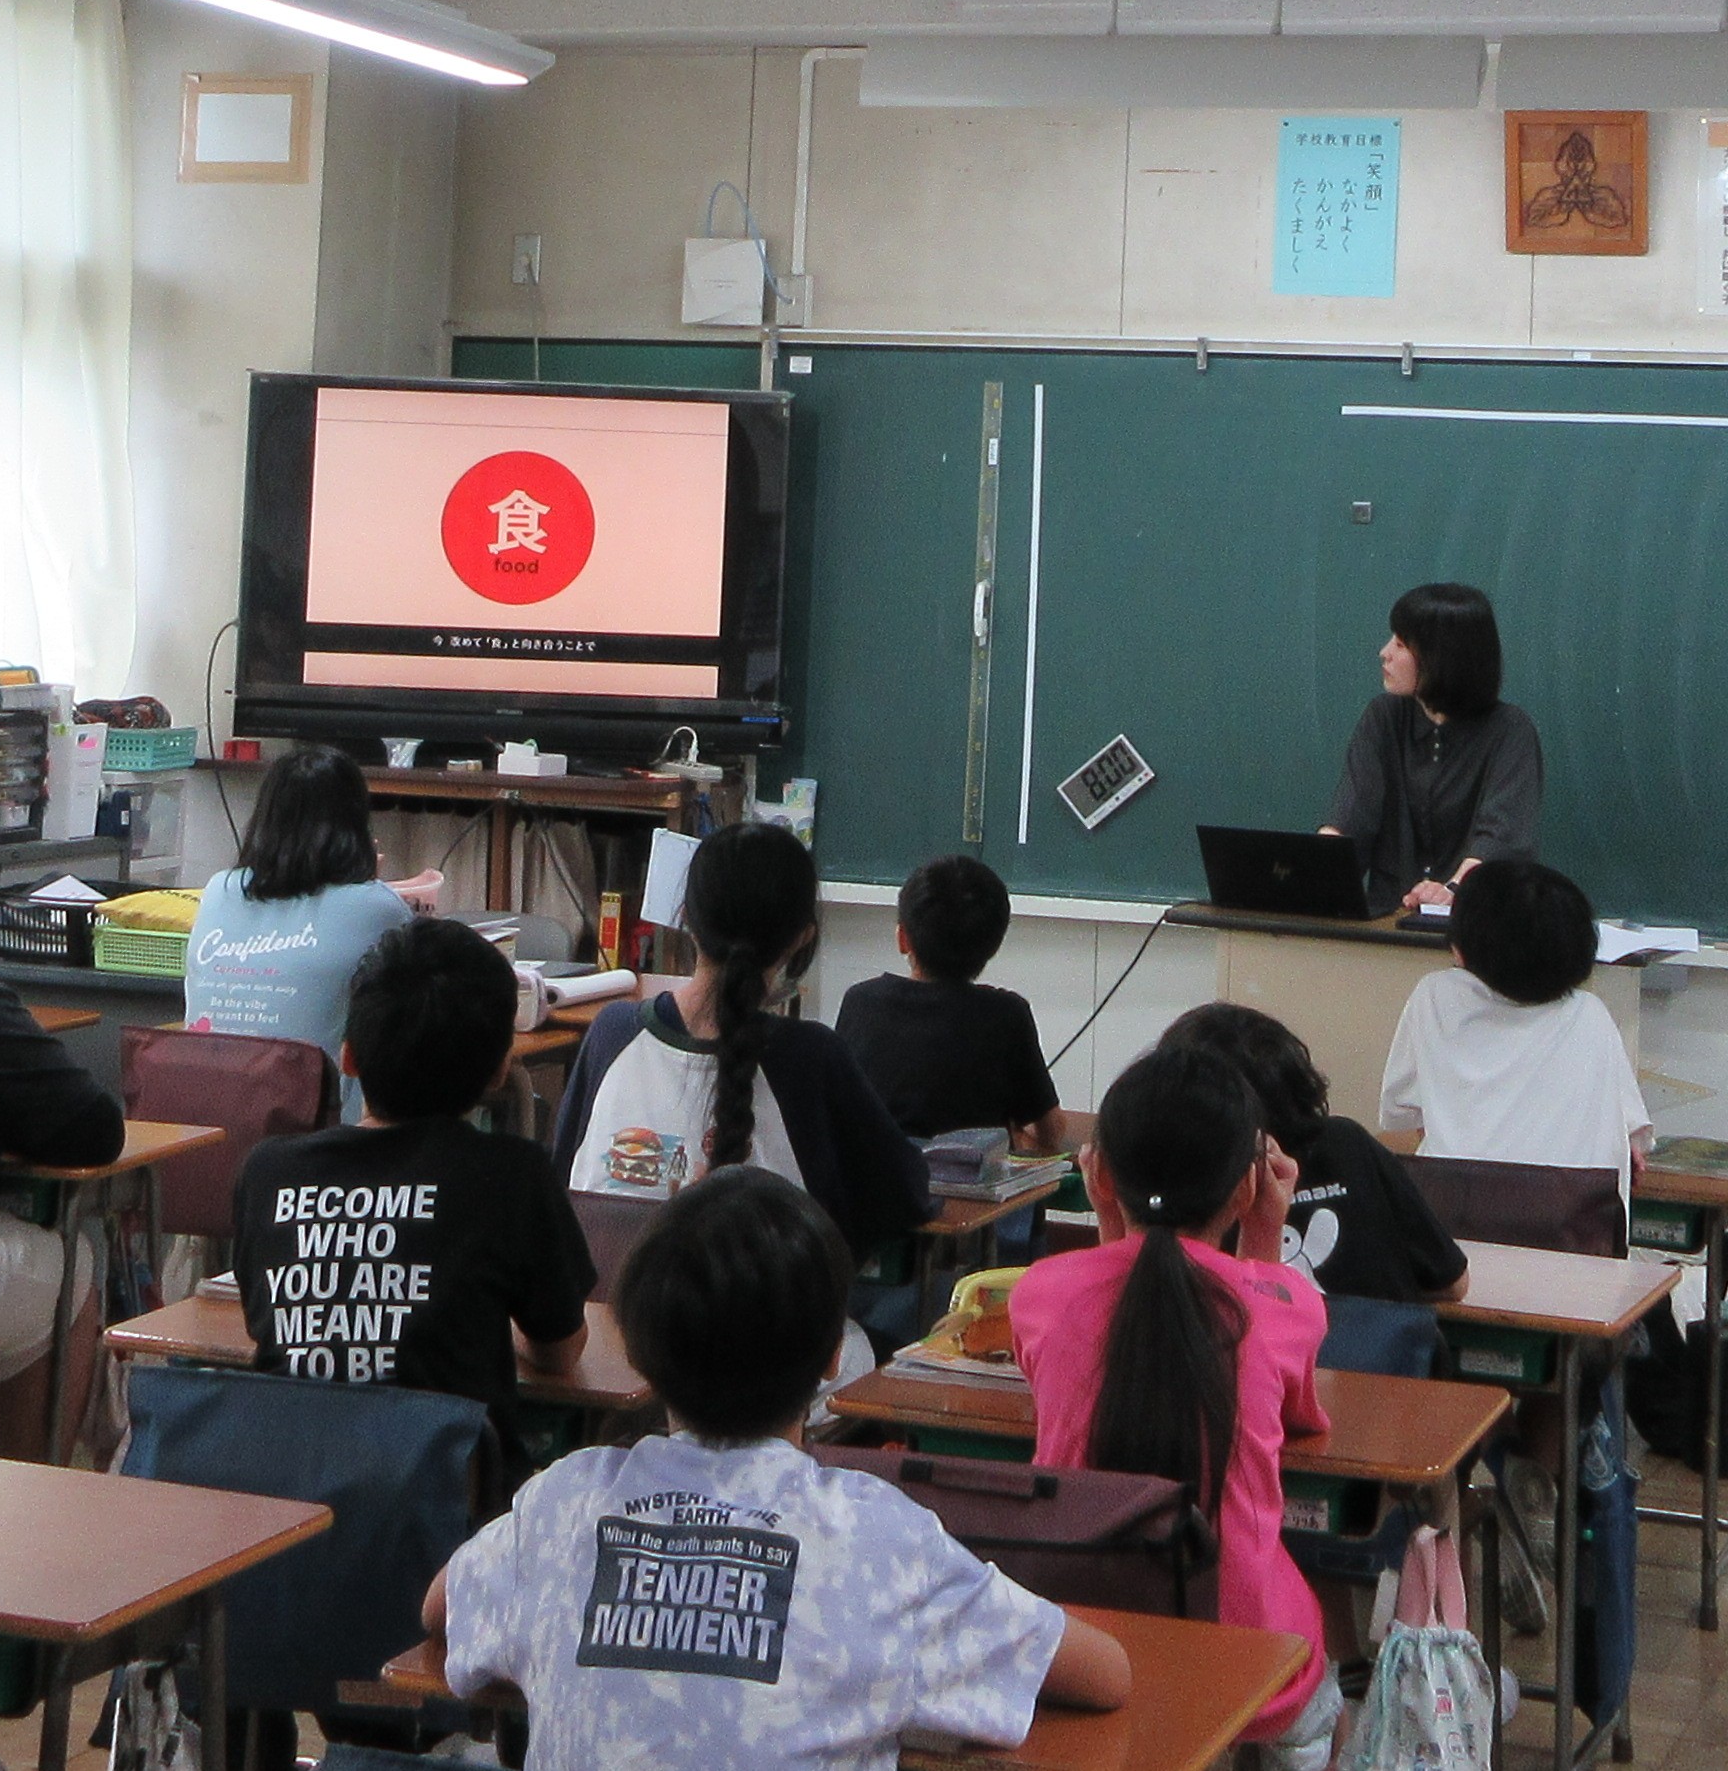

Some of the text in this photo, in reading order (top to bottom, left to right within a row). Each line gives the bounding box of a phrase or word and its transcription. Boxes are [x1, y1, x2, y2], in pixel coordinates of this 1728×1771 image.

[1296, 133, 1383, 147] 学校教育目標
[1291, 178, 1307, 273] たくましく
[1315, 178, 1333, 250] かんがえ
[1340, 178, 1357, 253] なかよく
[487, 489, 552, 555] 食
[495, 558, 539, 574] food
[274, 1184, 438, 1224] BECOME
[297, 1222, 397, 1258] WHO
[266, 1262, 432, 1304] YOU ARE
[274, 1304, 412, 1345] MEANT
[286, 1346, 397, 1383] TO BE
[624, 1490, 712, 1516] MYSTERY
[745, 1508, 783, 1530] THE
[673, 1507, 731, 1525] EARTH
[602, 1526, 793, 1568] What the earth wants to say
[617, 1556, 770, 1614] TENDER
[590, 1603, 779, 1663] MOMENT
